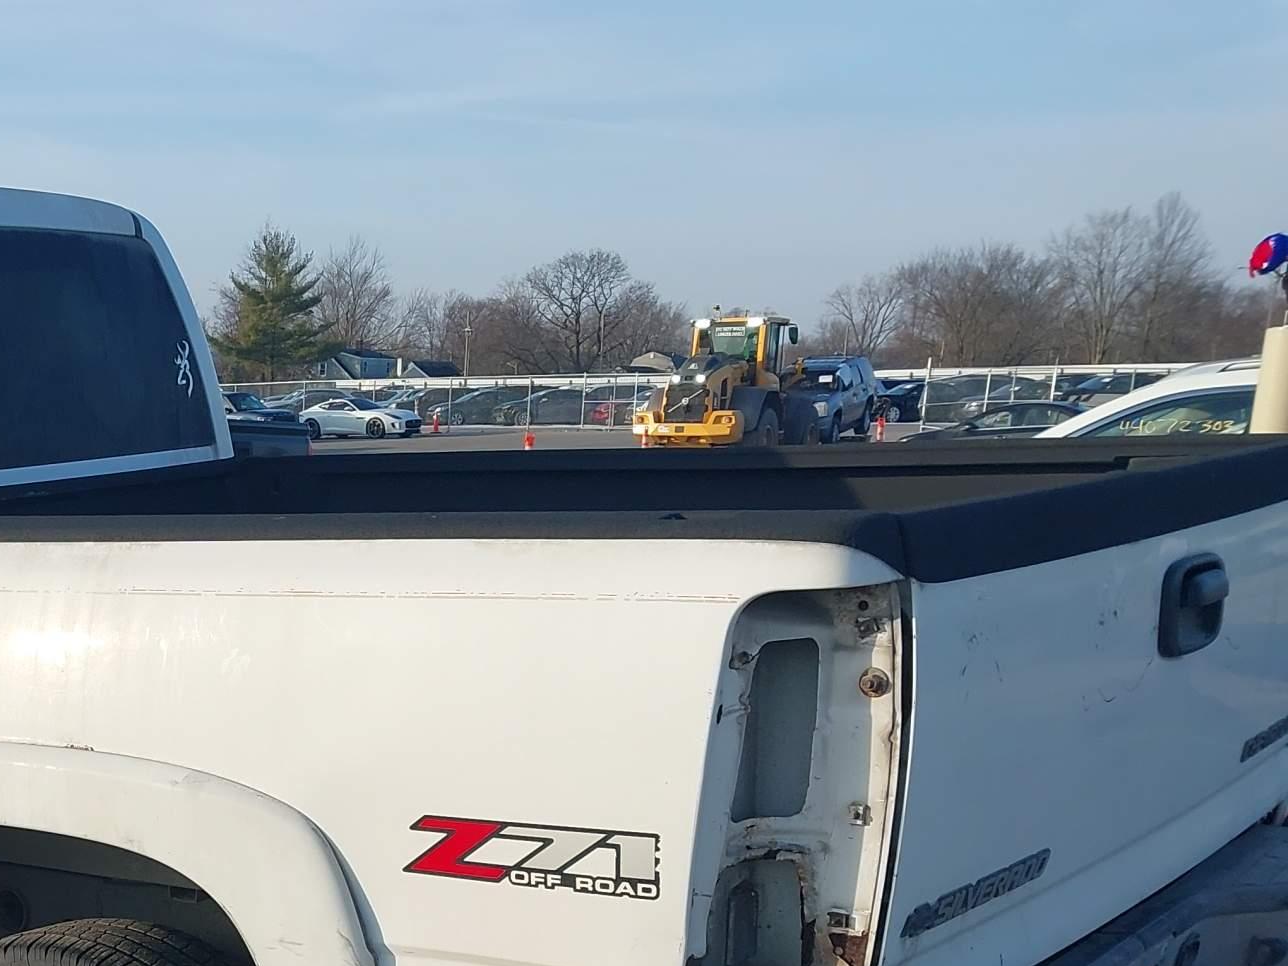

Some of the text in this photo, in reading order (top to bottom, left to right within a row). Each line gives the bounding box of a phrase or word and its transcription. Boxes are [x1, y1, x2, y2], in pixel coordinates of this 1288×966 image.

[403, 814, 661, 883] Z71
[509, 869, 659, 899] OFF ROAD
[933, 849, 1050, 925] SILVERADO
